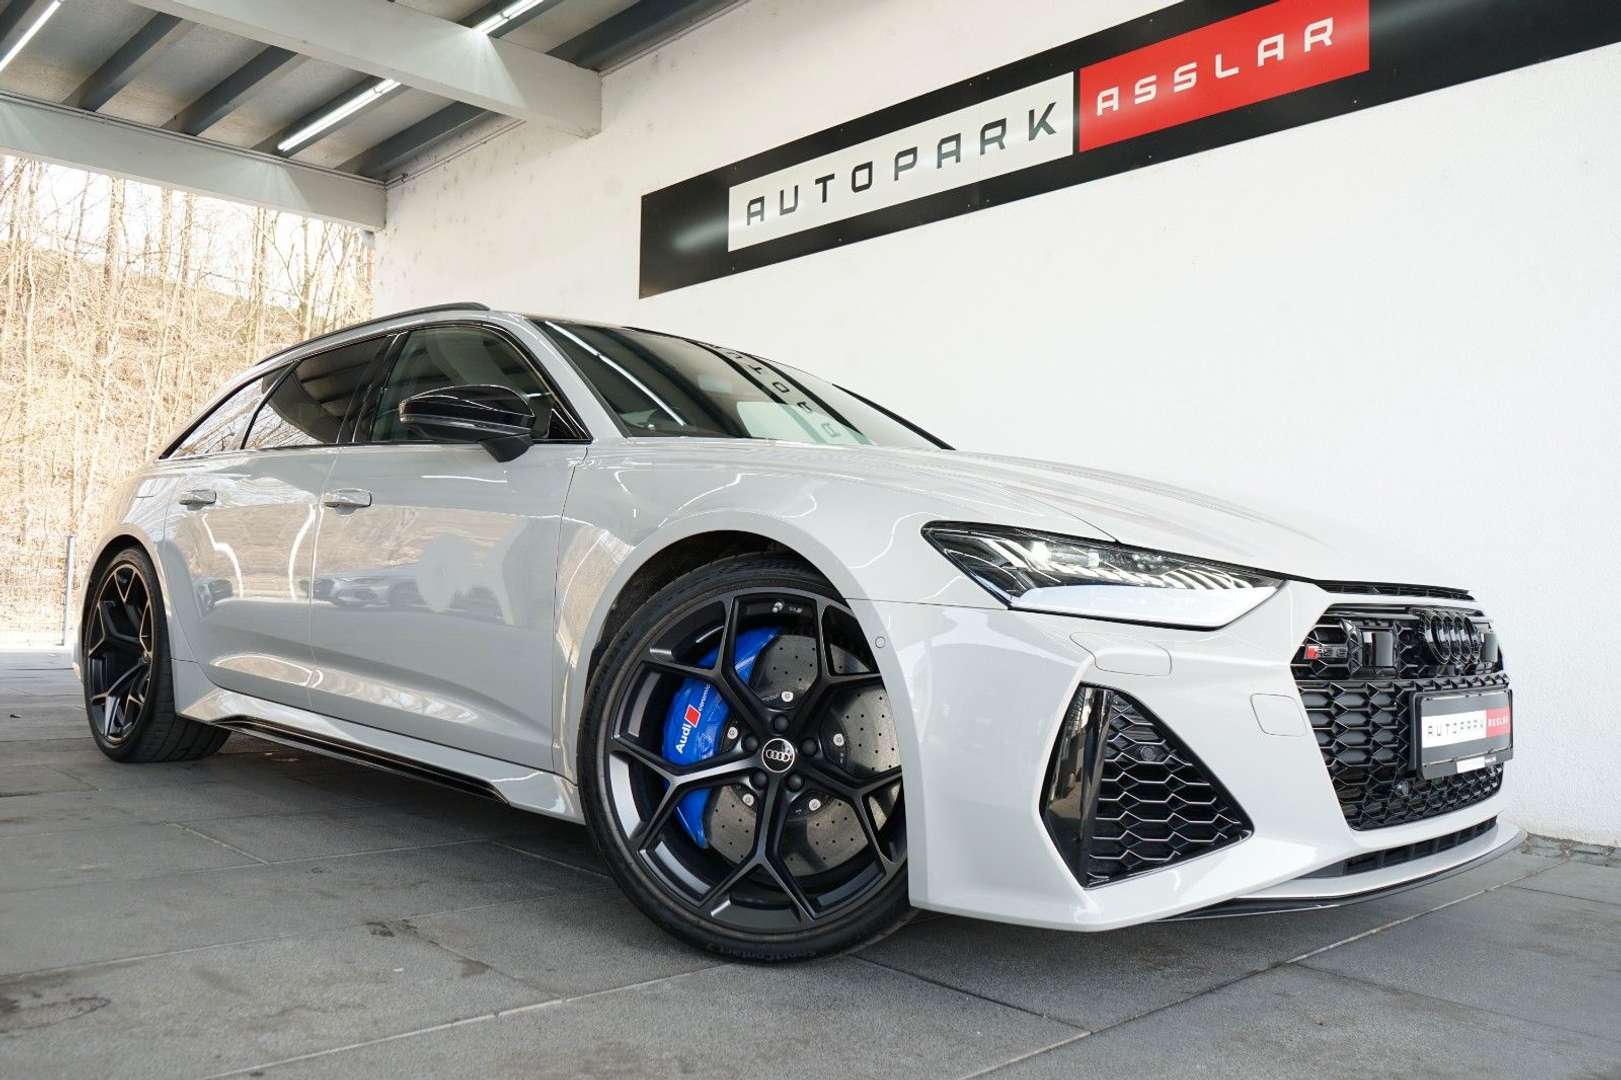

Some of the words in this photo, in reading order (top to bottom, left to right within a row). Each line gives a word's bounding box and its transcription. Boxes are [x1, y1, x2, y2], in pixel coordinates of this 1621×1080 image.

[746, 102, 1057, 226] AUTOPARK
[1096, 16, 1335, 116] ASSLAR
[675, 723, 692, 754] Audi
